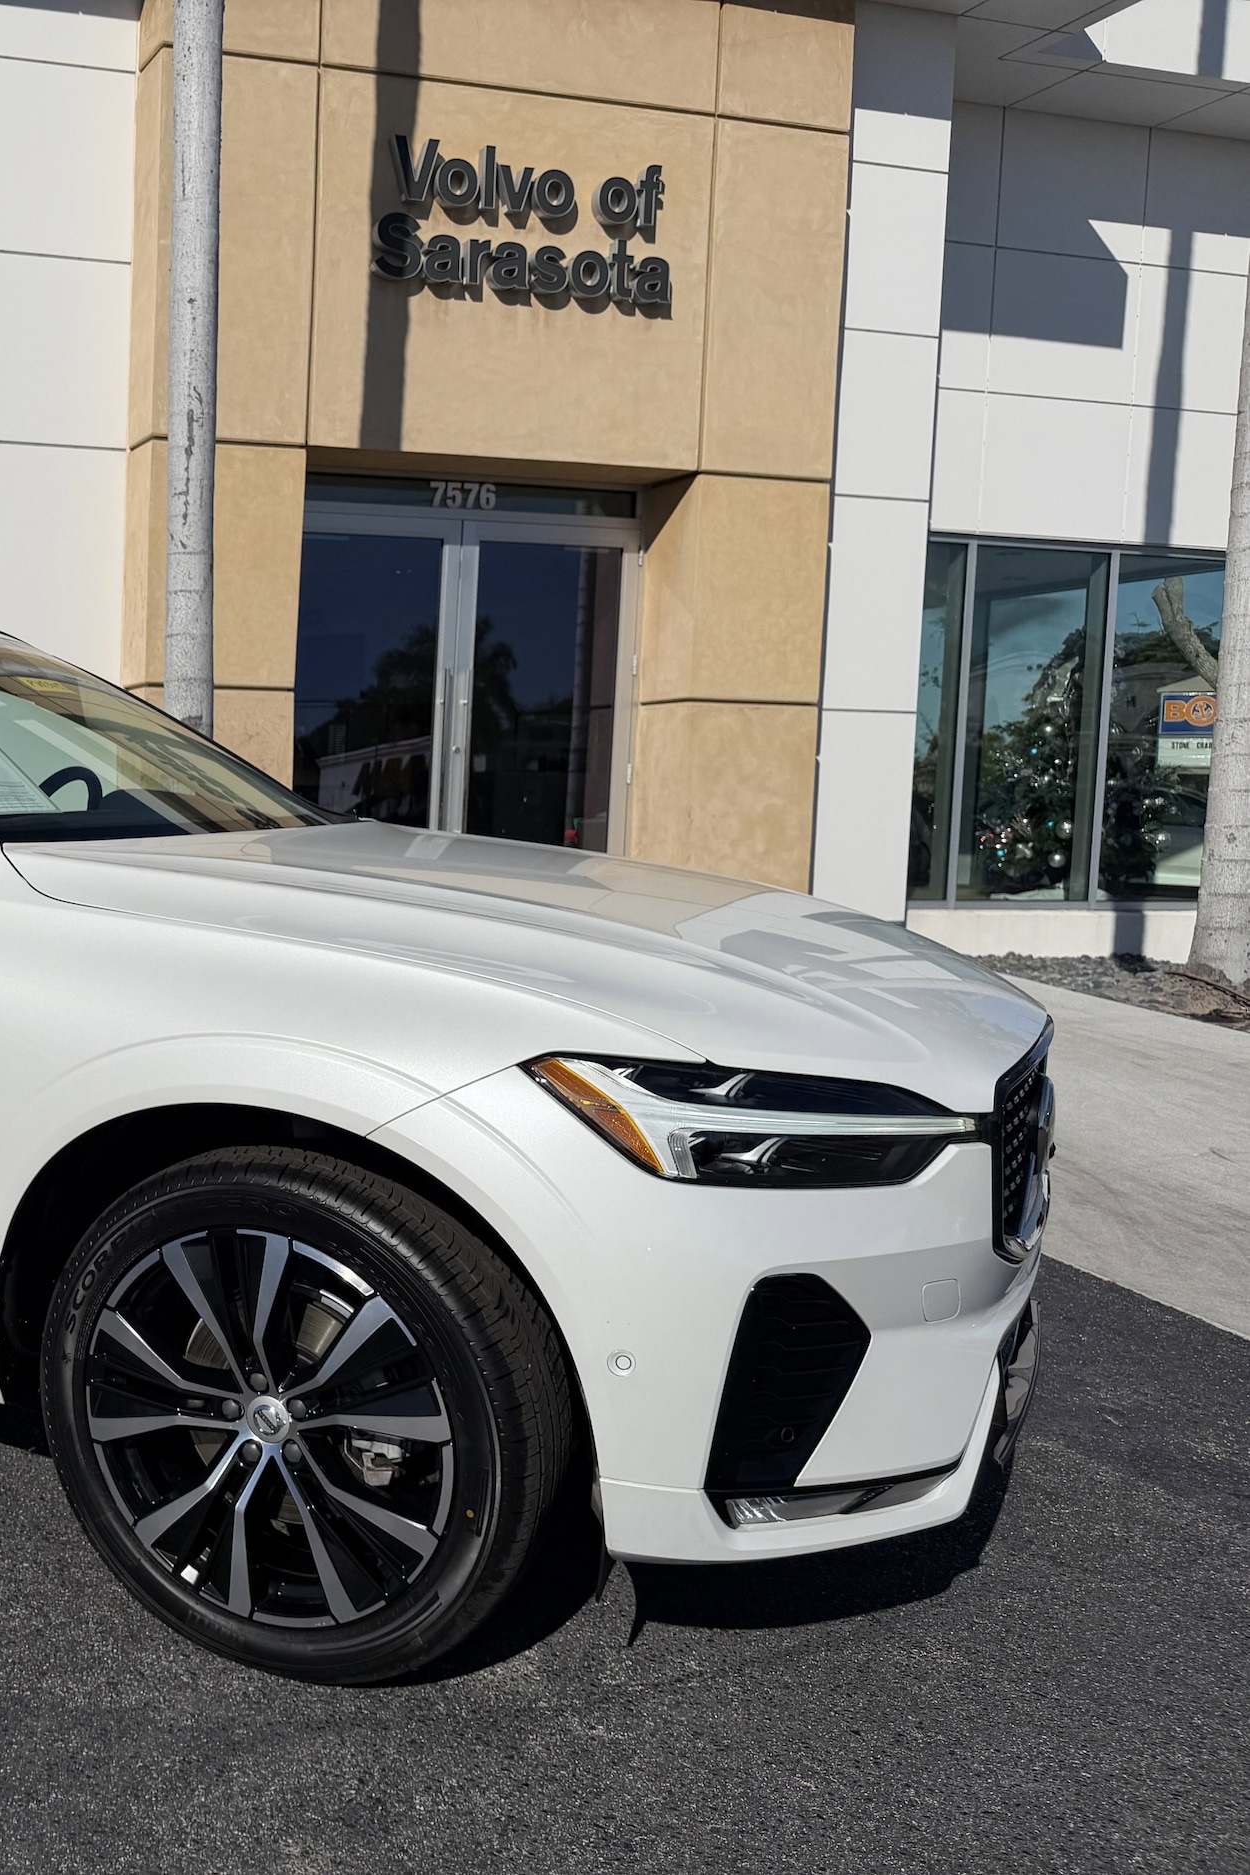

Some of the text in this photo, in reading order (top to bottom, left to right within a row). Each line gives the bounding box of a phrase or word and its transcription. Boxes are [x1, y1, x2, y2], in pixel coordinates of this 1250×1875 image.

[392, 134, 664, 227] Volvo of
[371, 212, 671, 304] Sarasota
[430, 481, 496, 510] 7576
[1164, 696, 1217, 726] BO
